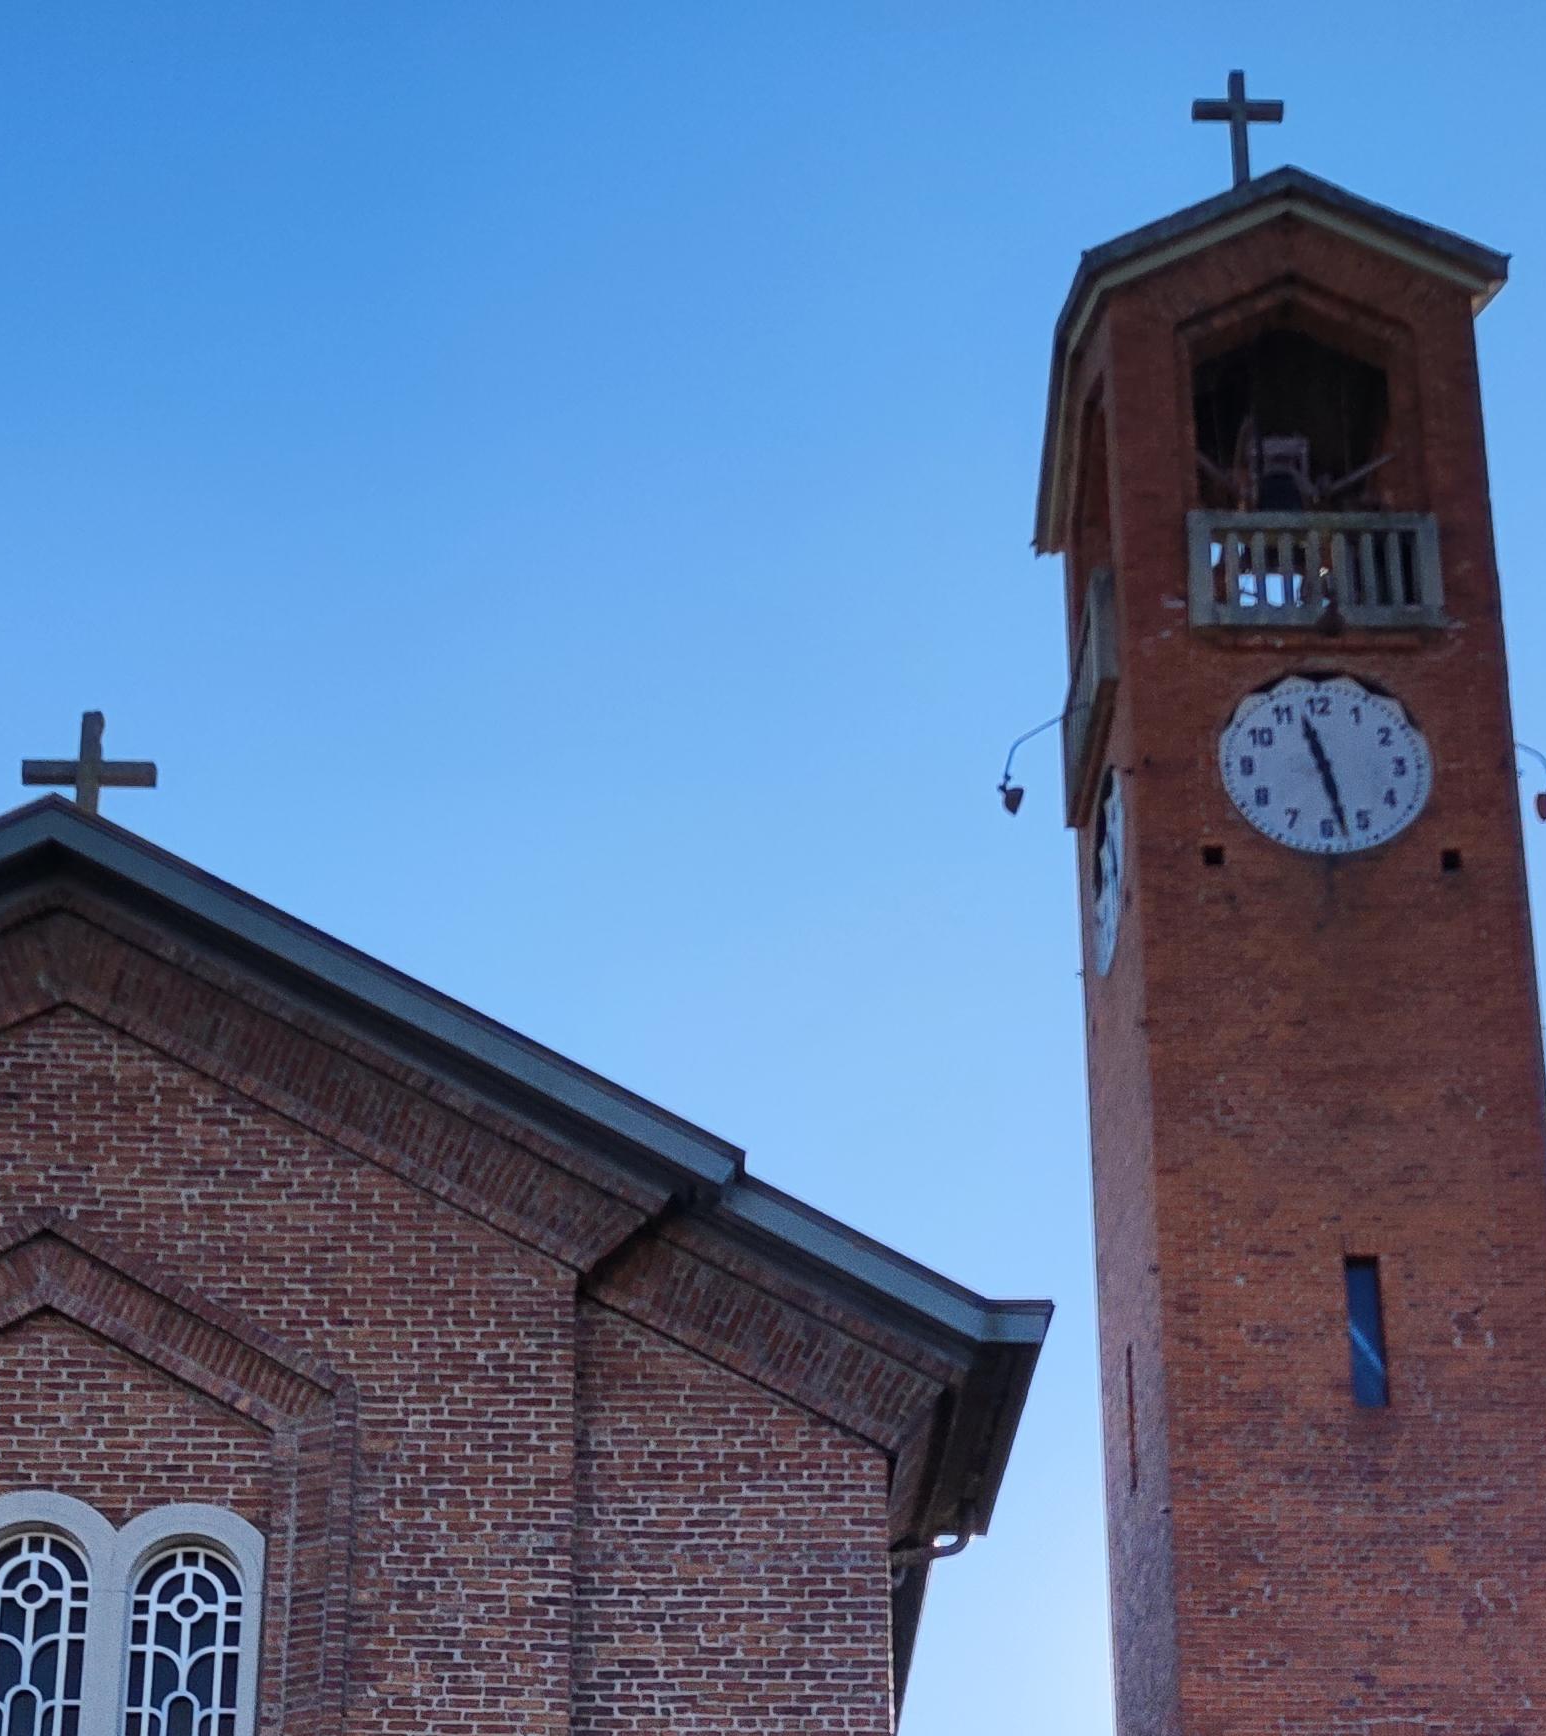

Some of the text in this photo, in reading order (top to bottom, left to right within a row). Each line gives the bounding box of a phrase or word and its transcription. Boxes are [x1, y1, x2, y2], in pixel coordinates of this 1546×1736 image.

[1273, 705, 1293, 724] 11
[1306, 697, 1331, 716] 12
[1351, 706, 1361, 724] 1
[1249, 727, 1273, 747] 10
[1378, 727, 1392, 746] 2
[1393, 756, 1406, 776] 3
[1384, 788, 1397, 808] 4
[1286, 807, 1300, 829] 7
[1357, 808, 1371, 830] 5
[1320, 819, 1334, 838] 6
